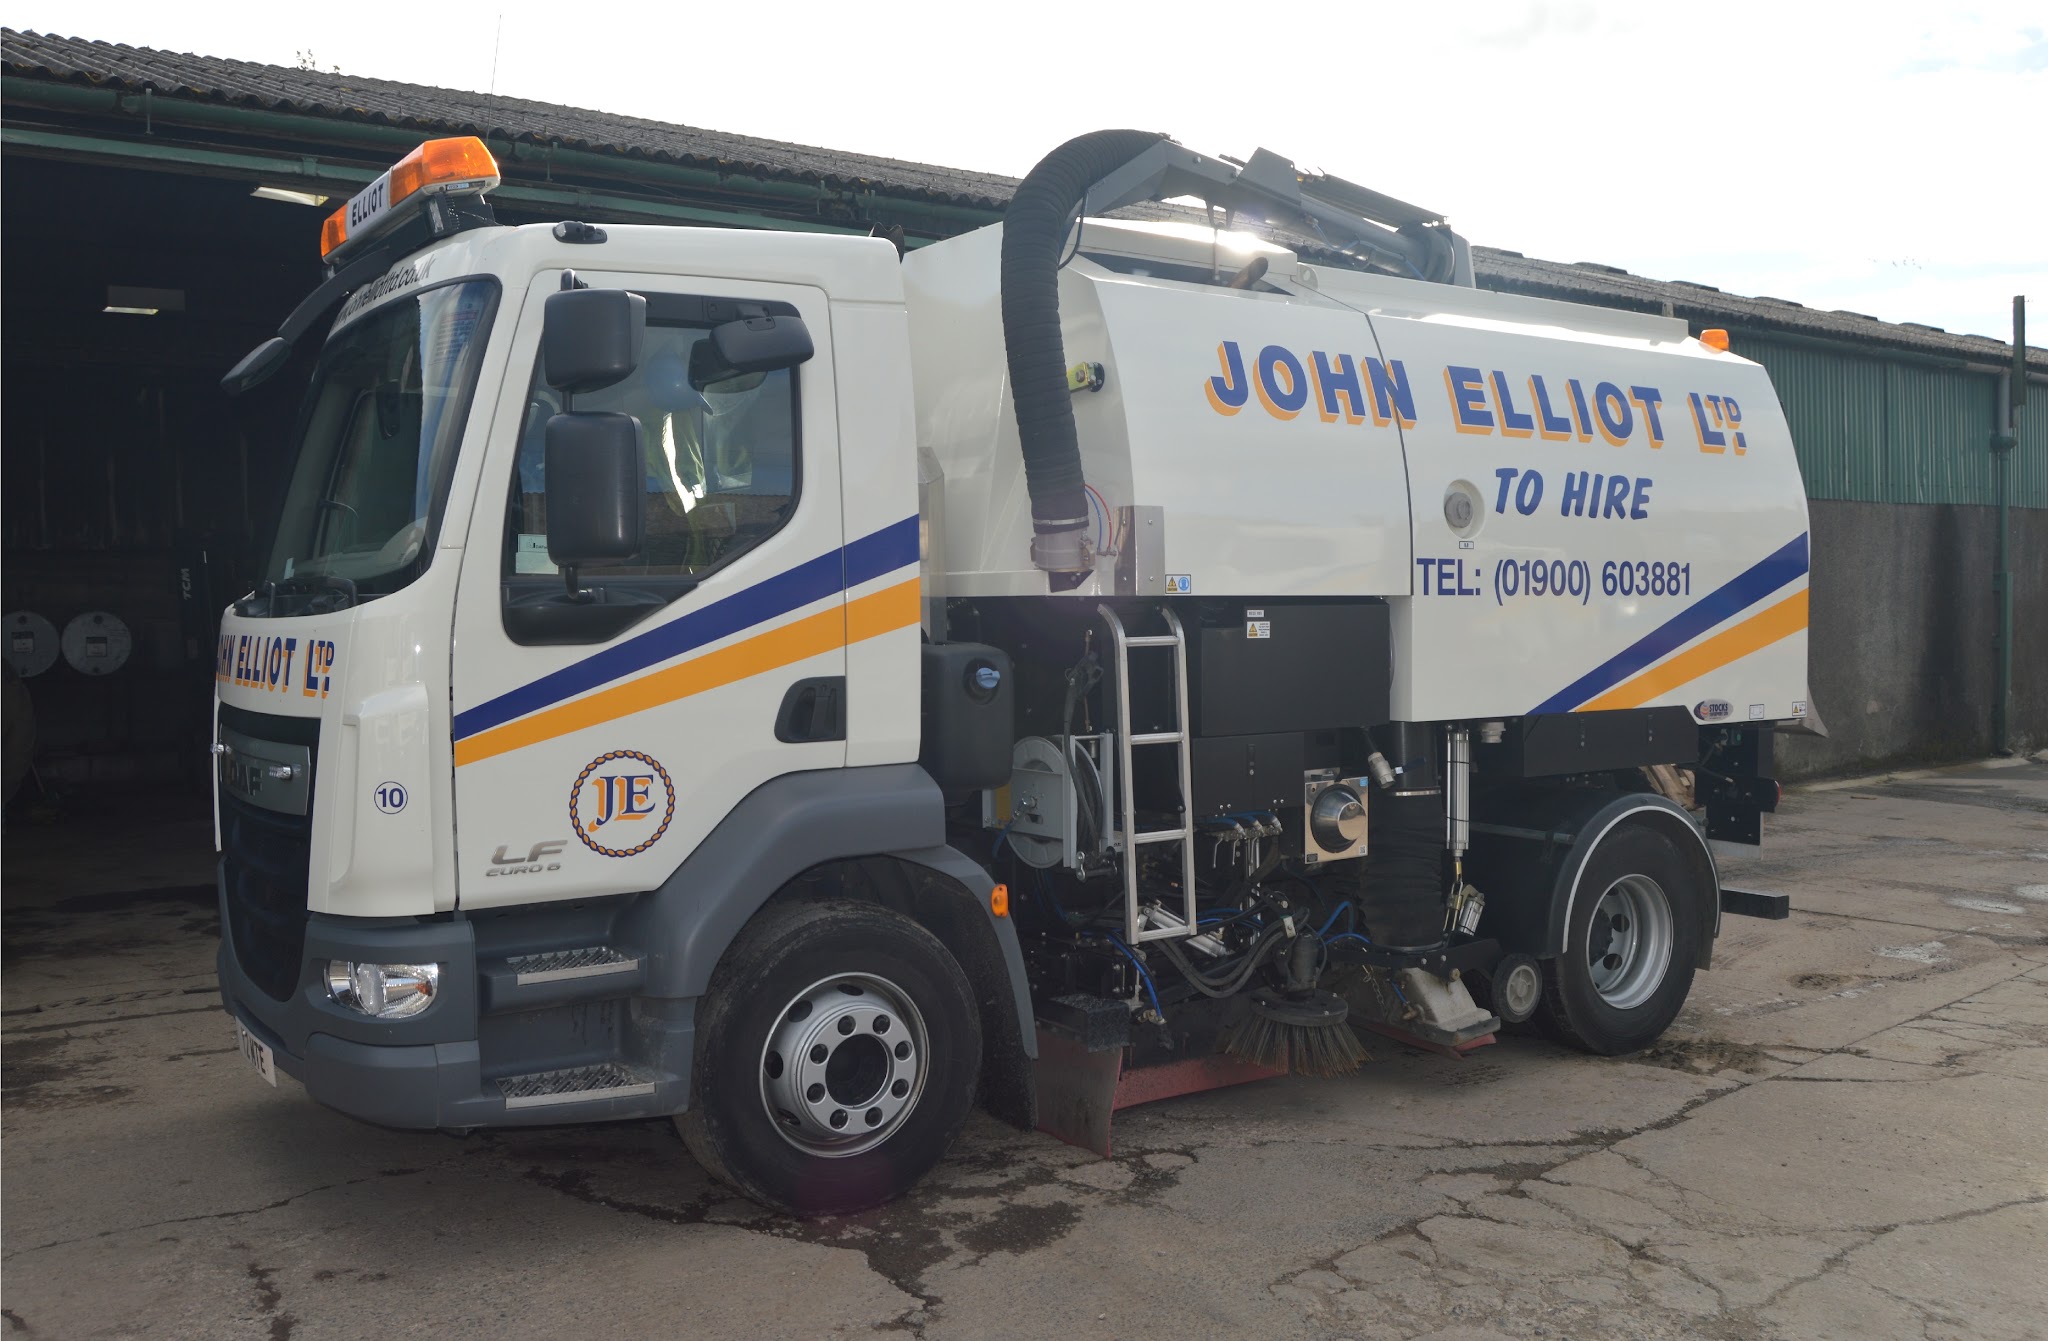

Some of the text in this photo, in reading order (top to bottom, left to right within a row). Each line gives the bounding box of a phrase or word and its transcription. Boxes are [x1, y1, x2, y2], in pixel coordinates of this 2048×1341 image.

[352, 183, 384, 228] ELLIOT
[1204, 340, 1418, 430] JOHN
[1443, 365, 1665, 450] ELLIOT
[1496, 467, 1653, 520] TO HIRE
[180, 568, 192, 600] TCM
[1416, 557, 1691, 606] TEL: (01900) 603881
[235, 635, 297, 693] ELLIOT
[1709, 703, 1728, 712] STOCKS
[377, 787, 404, 808] 10
[588, 774, 656, 833] JE
[485, 862, 561, 877] EURO 6
[491, 839, 568, 865] LF
